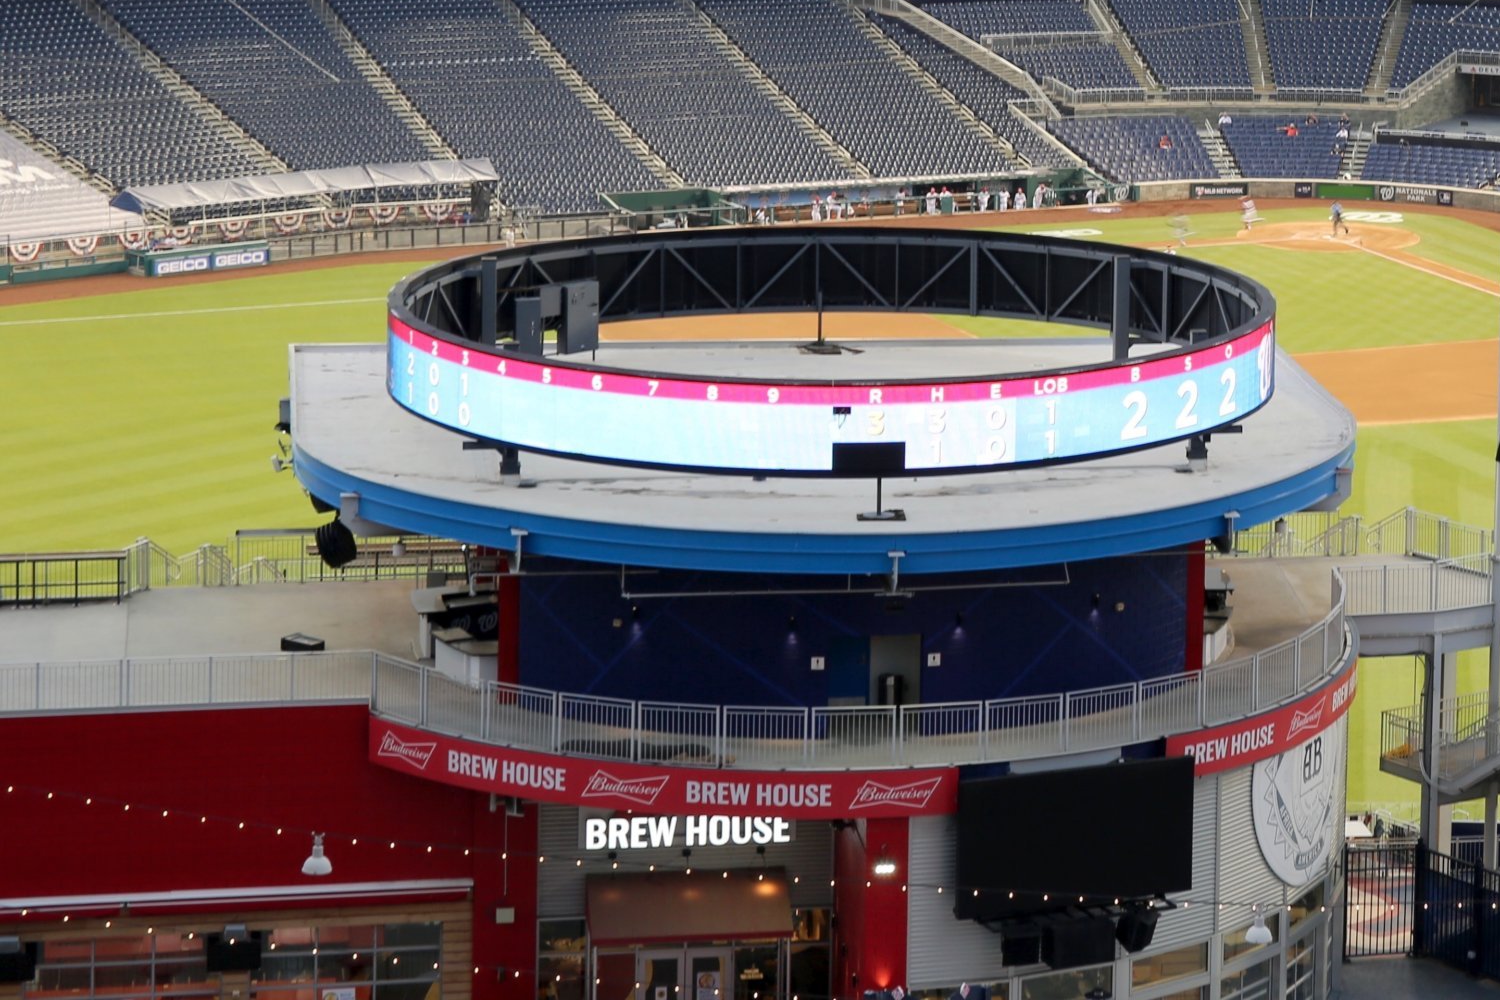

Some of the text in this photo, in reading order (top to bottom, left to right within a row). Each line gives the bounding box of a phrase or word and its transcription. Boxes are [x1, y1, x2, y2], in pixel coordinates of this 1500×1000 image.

[1204, 187, 1243, 195] MLB NETWORK
[1396, 187, 1438, 197] NATIONALS
[1406, 195, 1426, 203] PARK
[157, 258, 208, 274] GEICO
[215, 251, 265, 268] GEICO
[408, 330, 1068, 404] 1 2 3 4 5 6 7 8 9 R H E LOB
[1130, 344, 1233, 383] B S O
[407, 352, 1057, 436] 2 0 1 3 3 0 1
[1120, 367, 1237, 441] 2 2 2
[407, 381, 1057, 463] 1 0 0 1 0 1
[1331, 683, 1349, 713] BREW
[384, 735, 429, 761] Budweiser
[1230, 723, 1275, 757] HOUSE
[448, 750, 567, 792] BREW HOUSE
[588, 774, 660, 797] Budweiser
[686, 780, 832, 808] BREW HOUSE
[857, 783, 932, 803] Budweiser
[585, 815, 791, 850] BREW HOUSE
